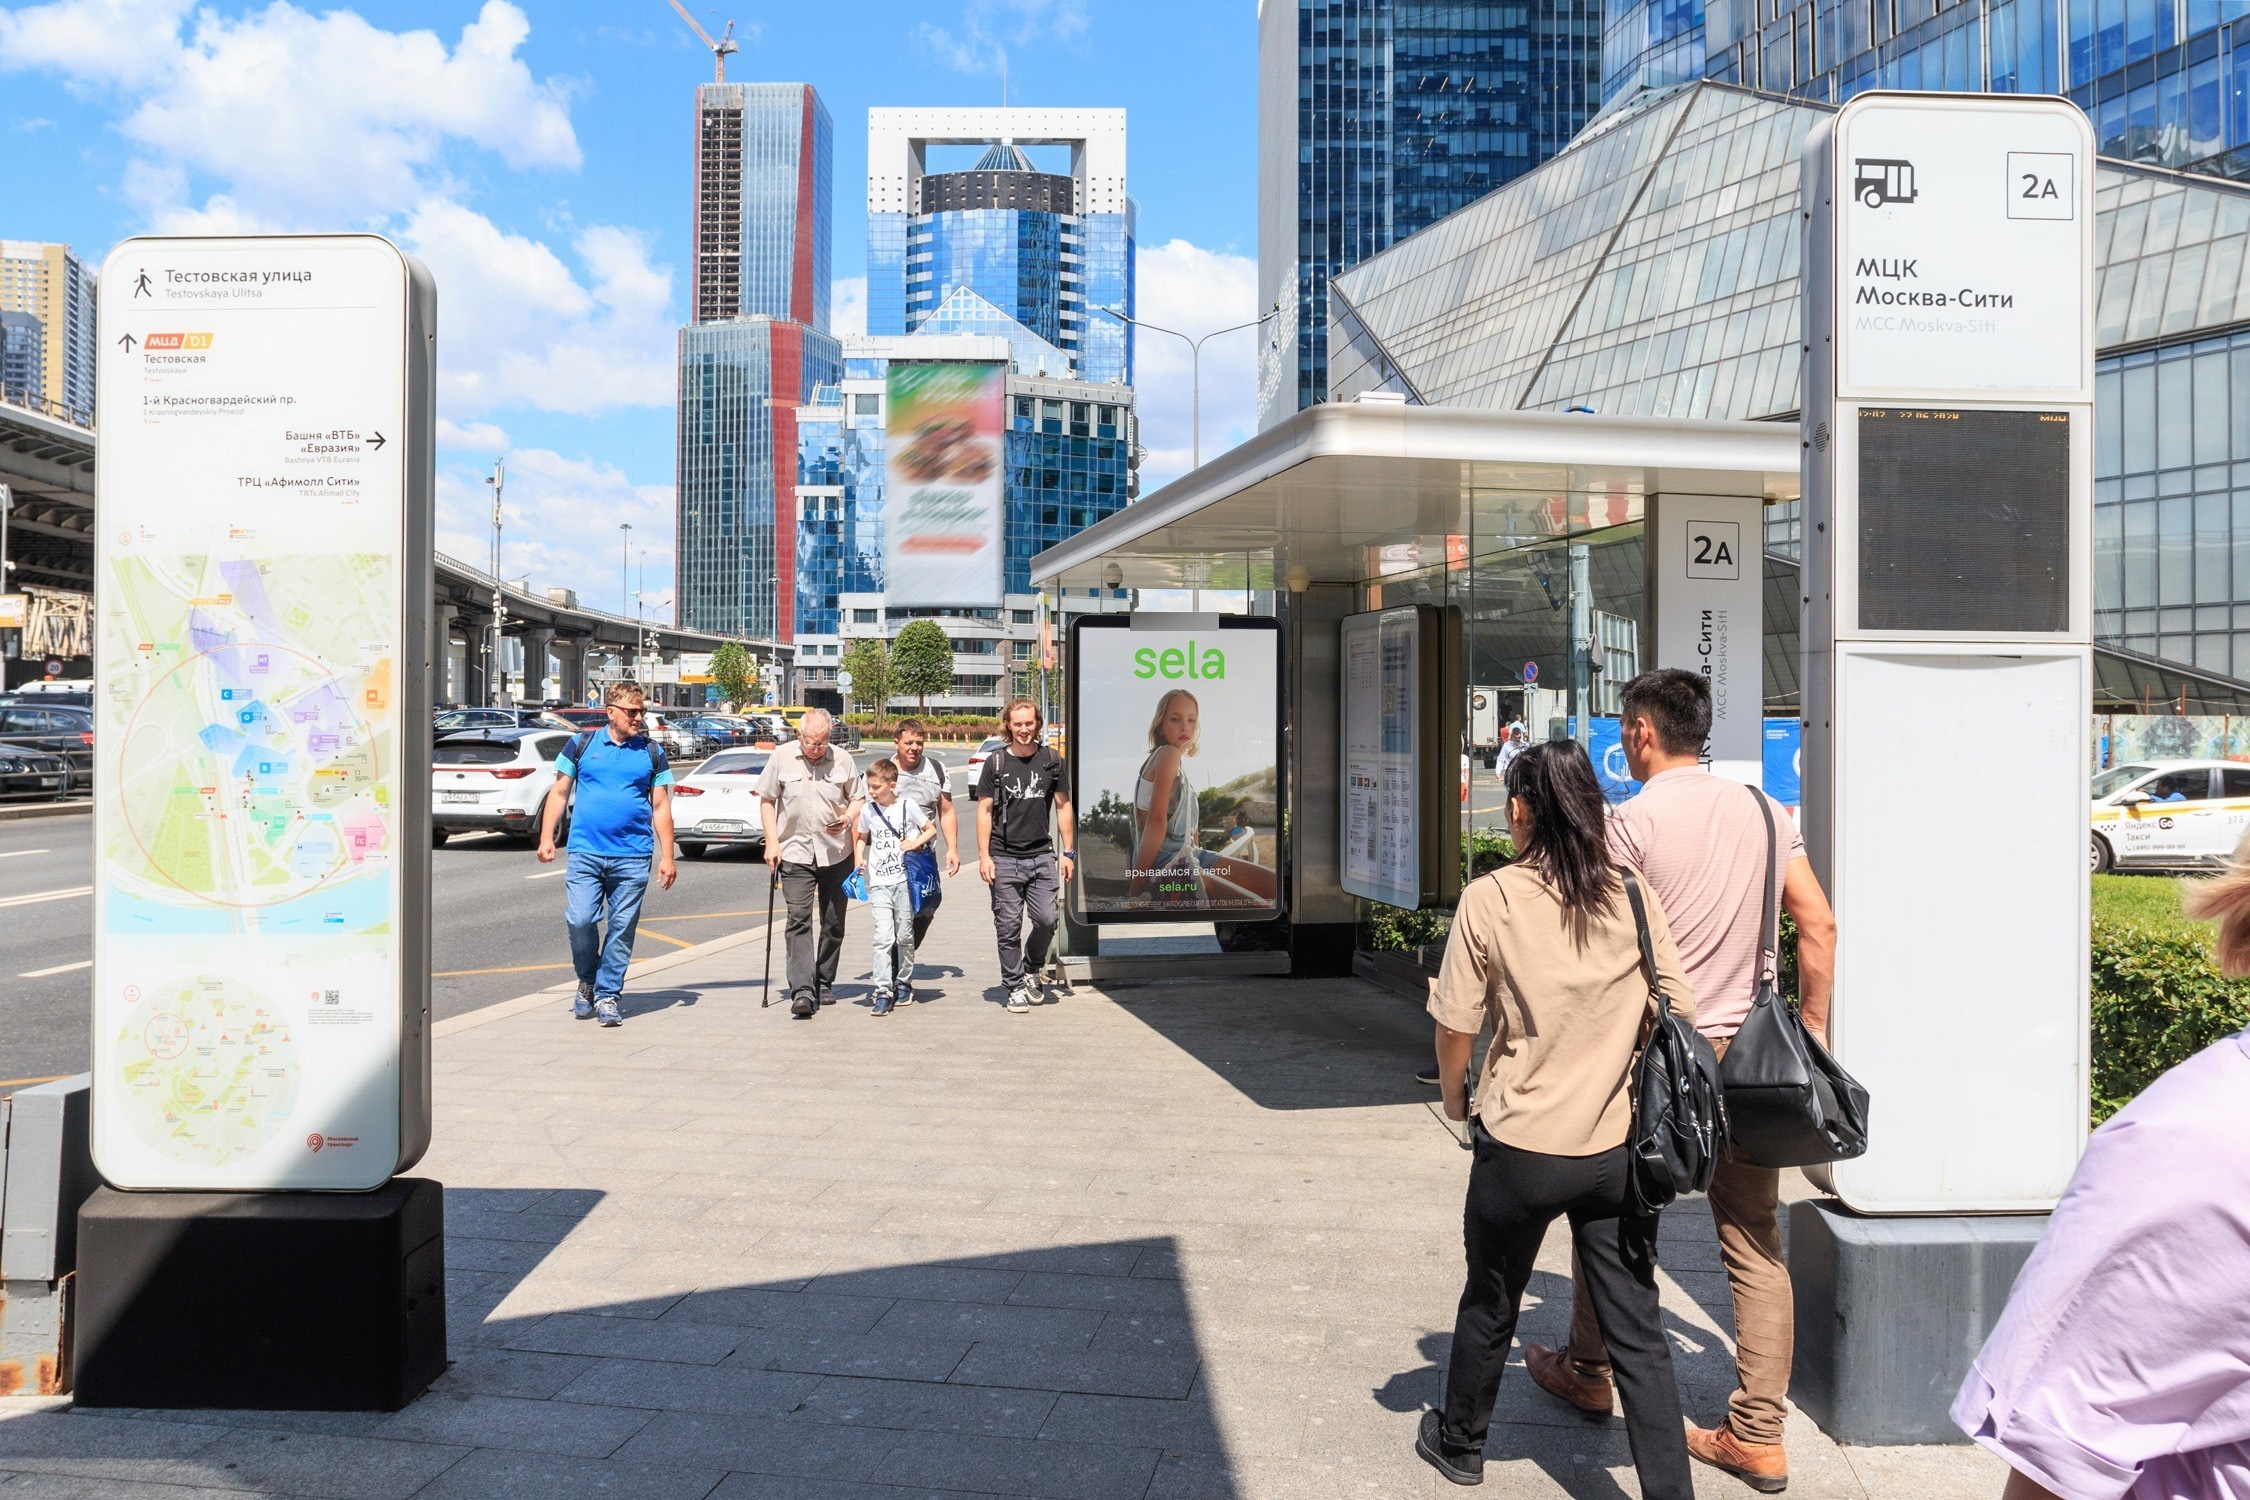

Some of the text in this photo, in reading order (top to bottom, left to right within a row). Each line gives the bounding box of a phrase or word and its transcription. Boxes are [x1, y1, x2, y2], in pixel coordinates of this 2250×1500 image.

[1854, 257, 1919, 282] МЦК
[164, 269, 312, 284] Тестовская улица
[164, 288, 263, 300] Testovskaya Ulitsa
[1854, 285, 2014, 309] Москва-Сити
[1854, 316, 1997, 334] MCC Moskva-Siti
[143, 354, 206, 364] Тестовская
[144, 366, 188, 375] Testovskaya
[143, 395, 297, 407] 1-й Красногвардейский пр.
[285, 430, 361, 441] Башня «ВТБ»
[300, 443, 361, 454] «Евразия»
[238, 476, 361, 488] ТРЦ «Афимолл Сити»
[1133, 640, 1226, 680] sela
[1716, 611, 1728, 720] MCC Moskva-Siti
[2124, 818, 2173, 830] Яндекс Go
[2126, 833, 2151, 841] Такси
[1124, 865, 1231, 879] врываемся в лето!
[1158, 880, 1198, 892] sela.ru
